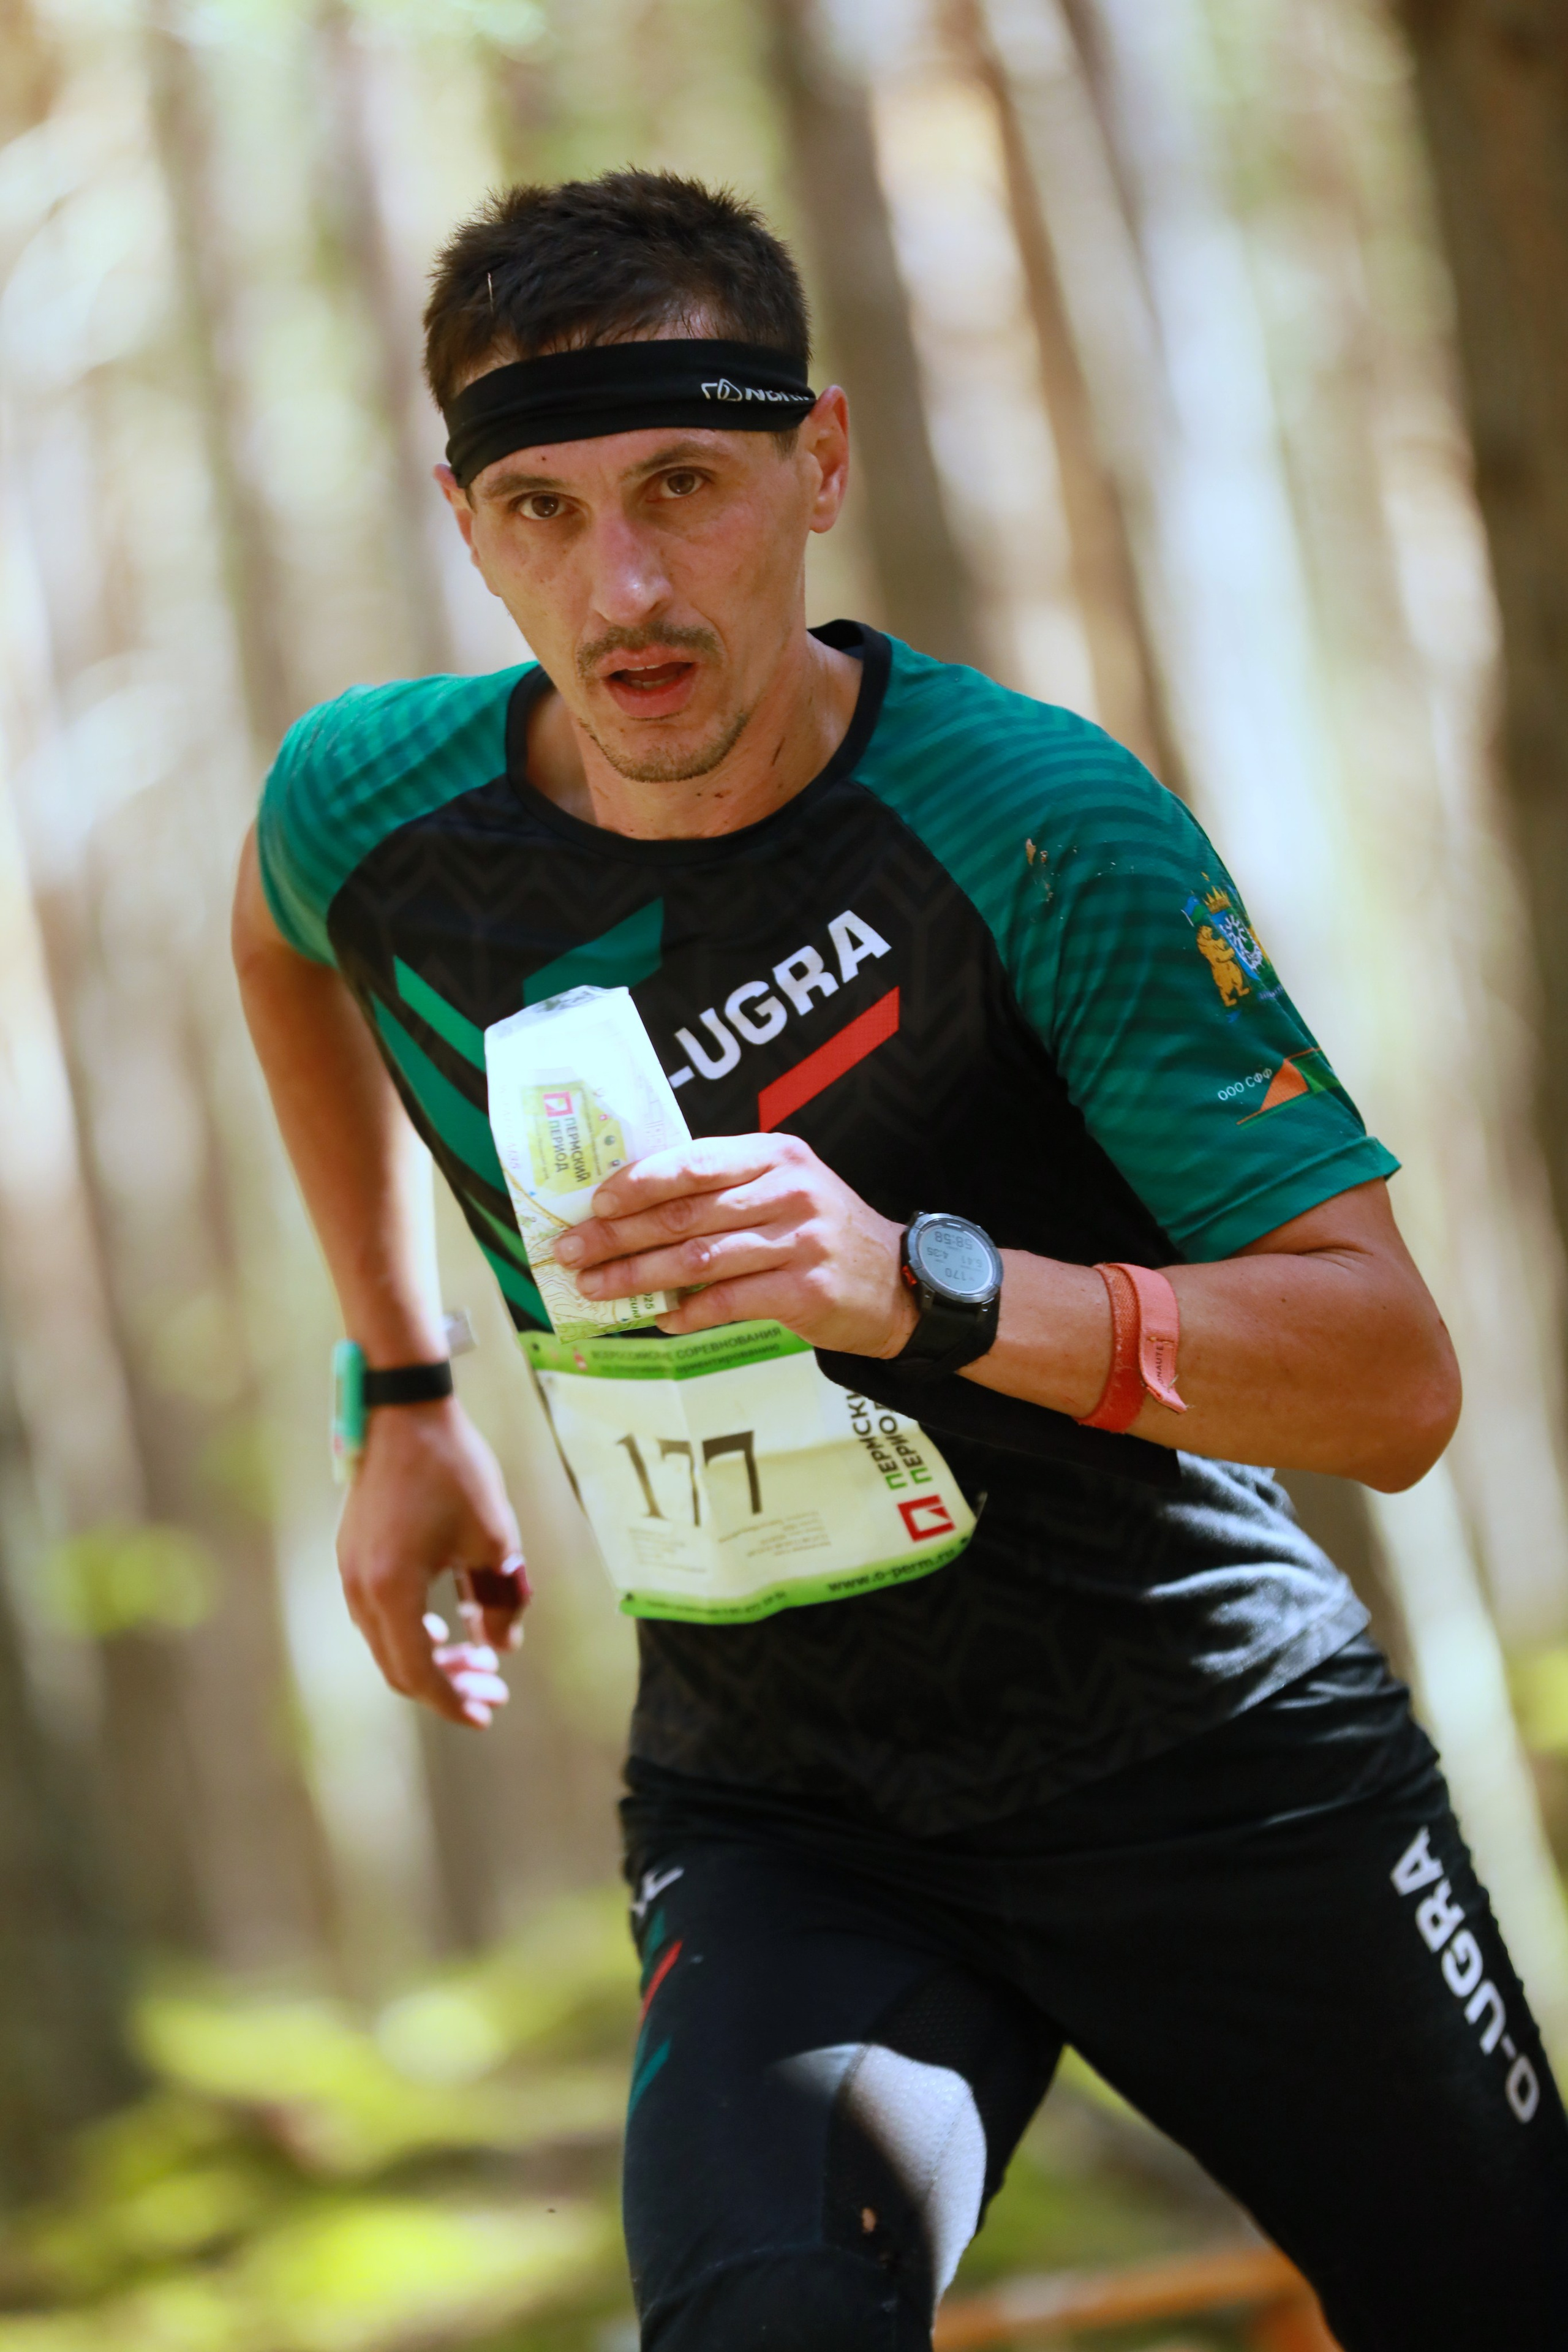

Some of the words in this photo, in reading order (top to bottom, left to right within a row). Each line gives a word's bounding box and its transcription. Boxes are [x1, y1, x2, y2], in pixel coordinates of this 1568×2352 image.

[549, 1120, 568, 1172] ПЕРИОД
[564, 1117, 591, 1182] ПЕРМСКИЙ
[616, 1430, 761, 1526] 177
[1390, 1825, 1540, 2124] O-UGRA
